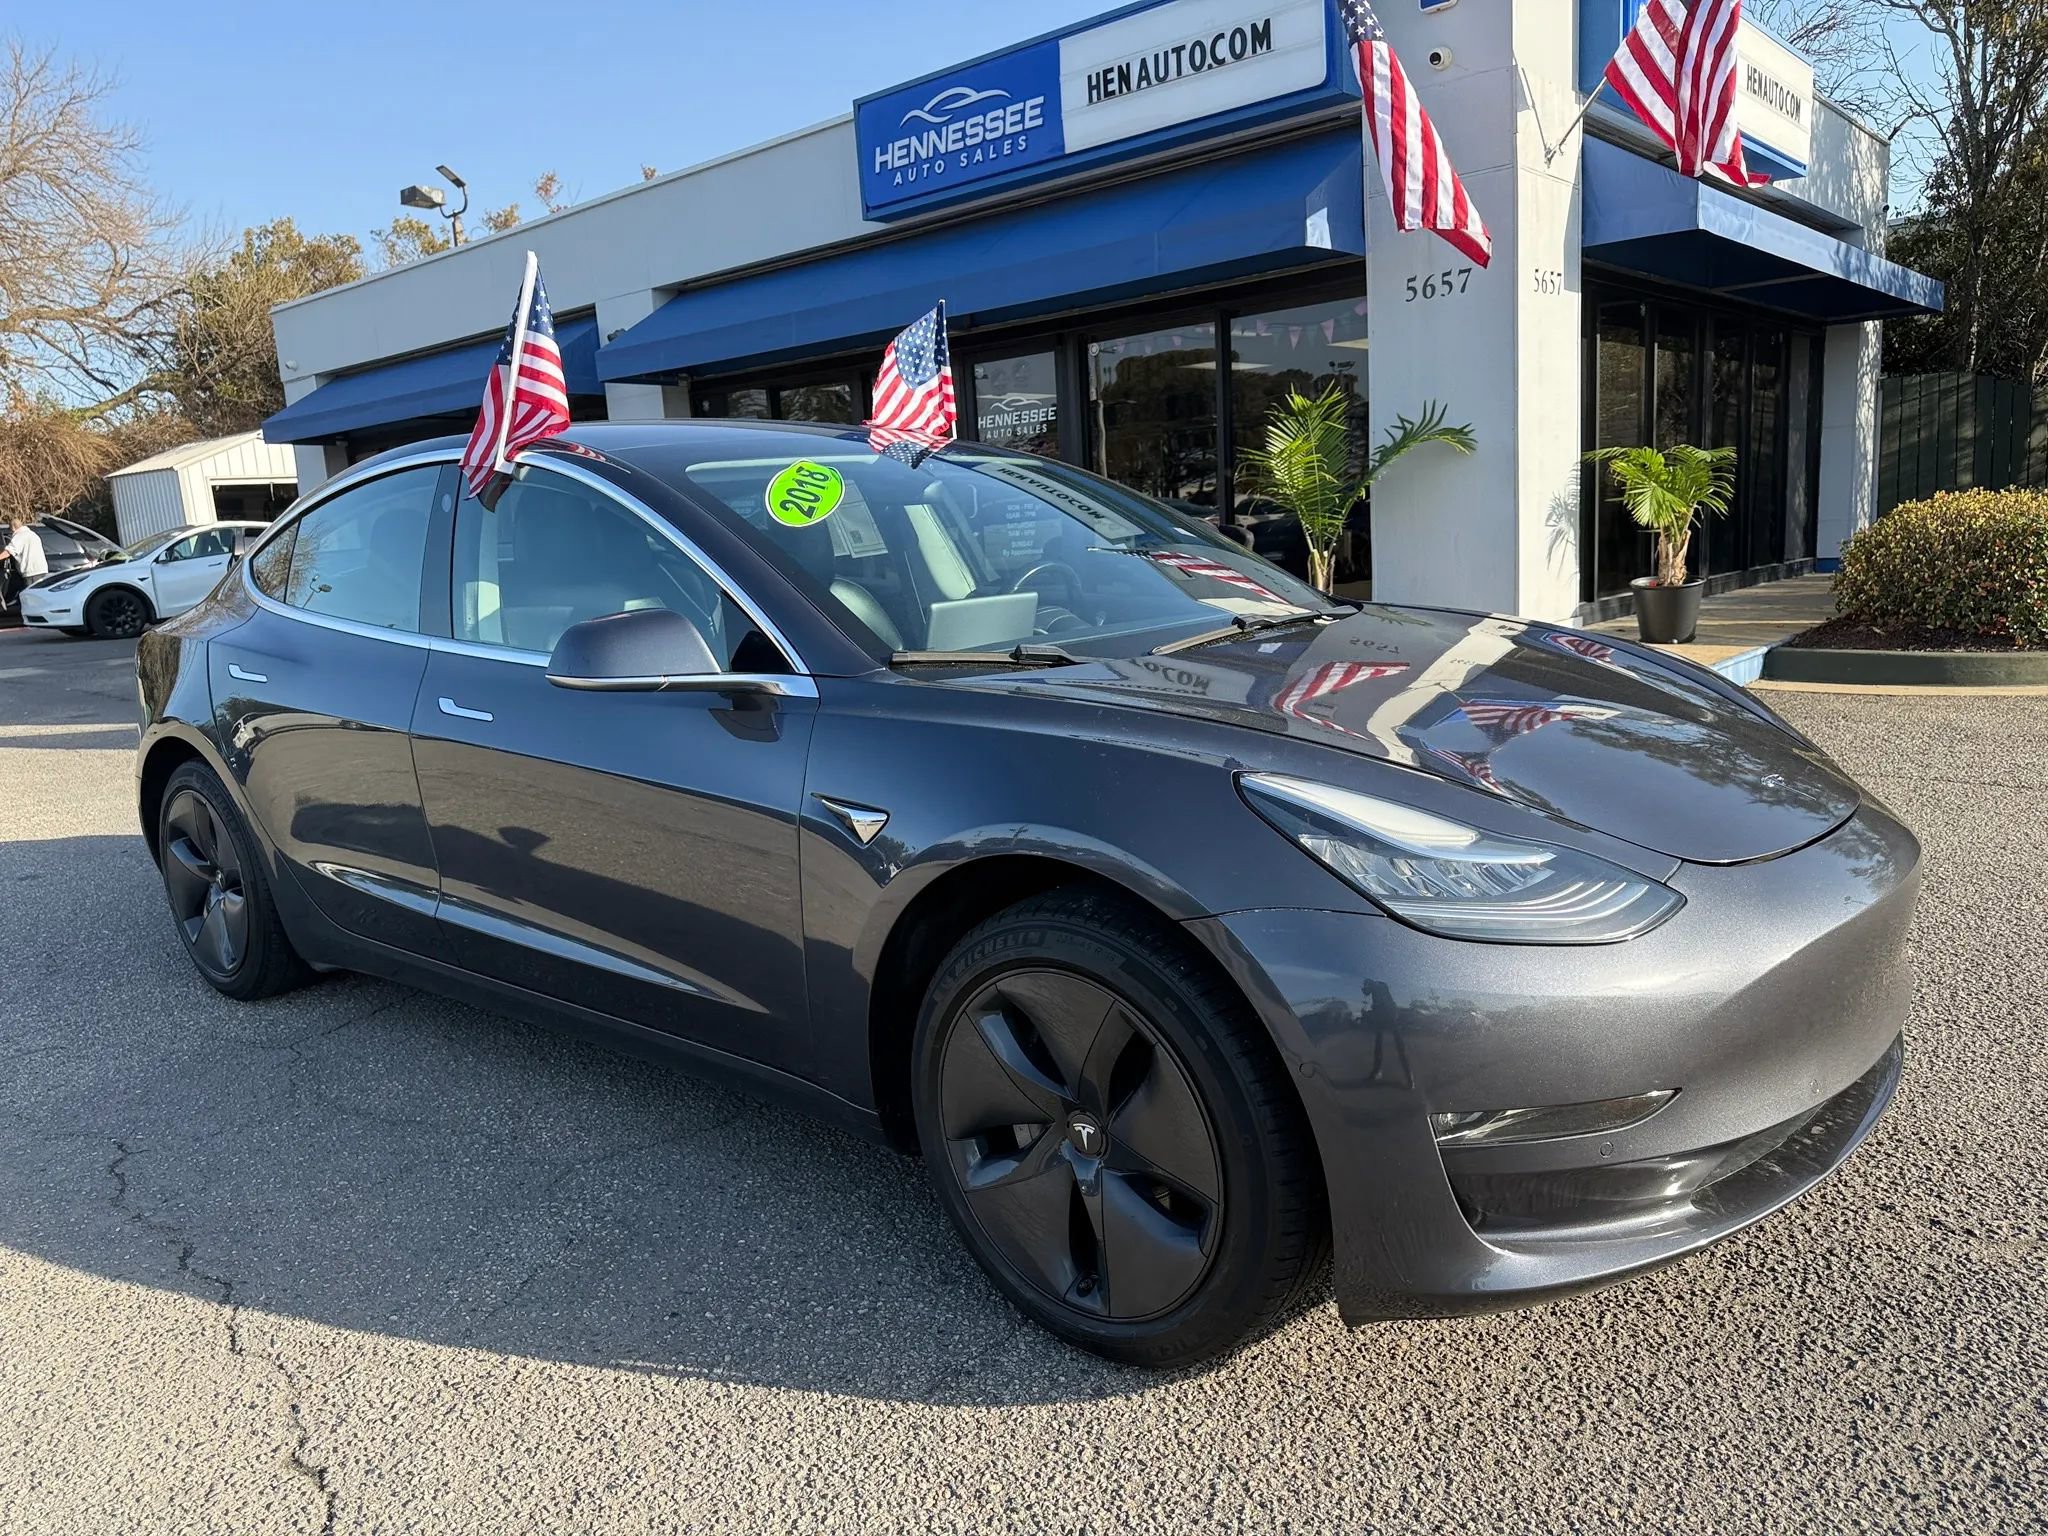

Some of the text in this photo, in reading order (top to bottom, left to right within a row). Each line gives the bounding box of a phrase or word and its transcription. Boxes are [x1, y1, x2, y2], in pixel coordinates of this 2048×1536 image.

[1086, 17, 1272, 104] HENAUTO.COM
[874, 95, 1045, 174] HENNESSEE
[892, 135, 1028, 187] AUTO SALES
[1405, 267, 1473, 303] 5657
[1533, 268, 1563, 296] 5657
[977, 406, 1057, 430] HENNESSEE
[986, 423, 1048, 440] AUTO SALES
[779, 465, 831, 519] 2018
